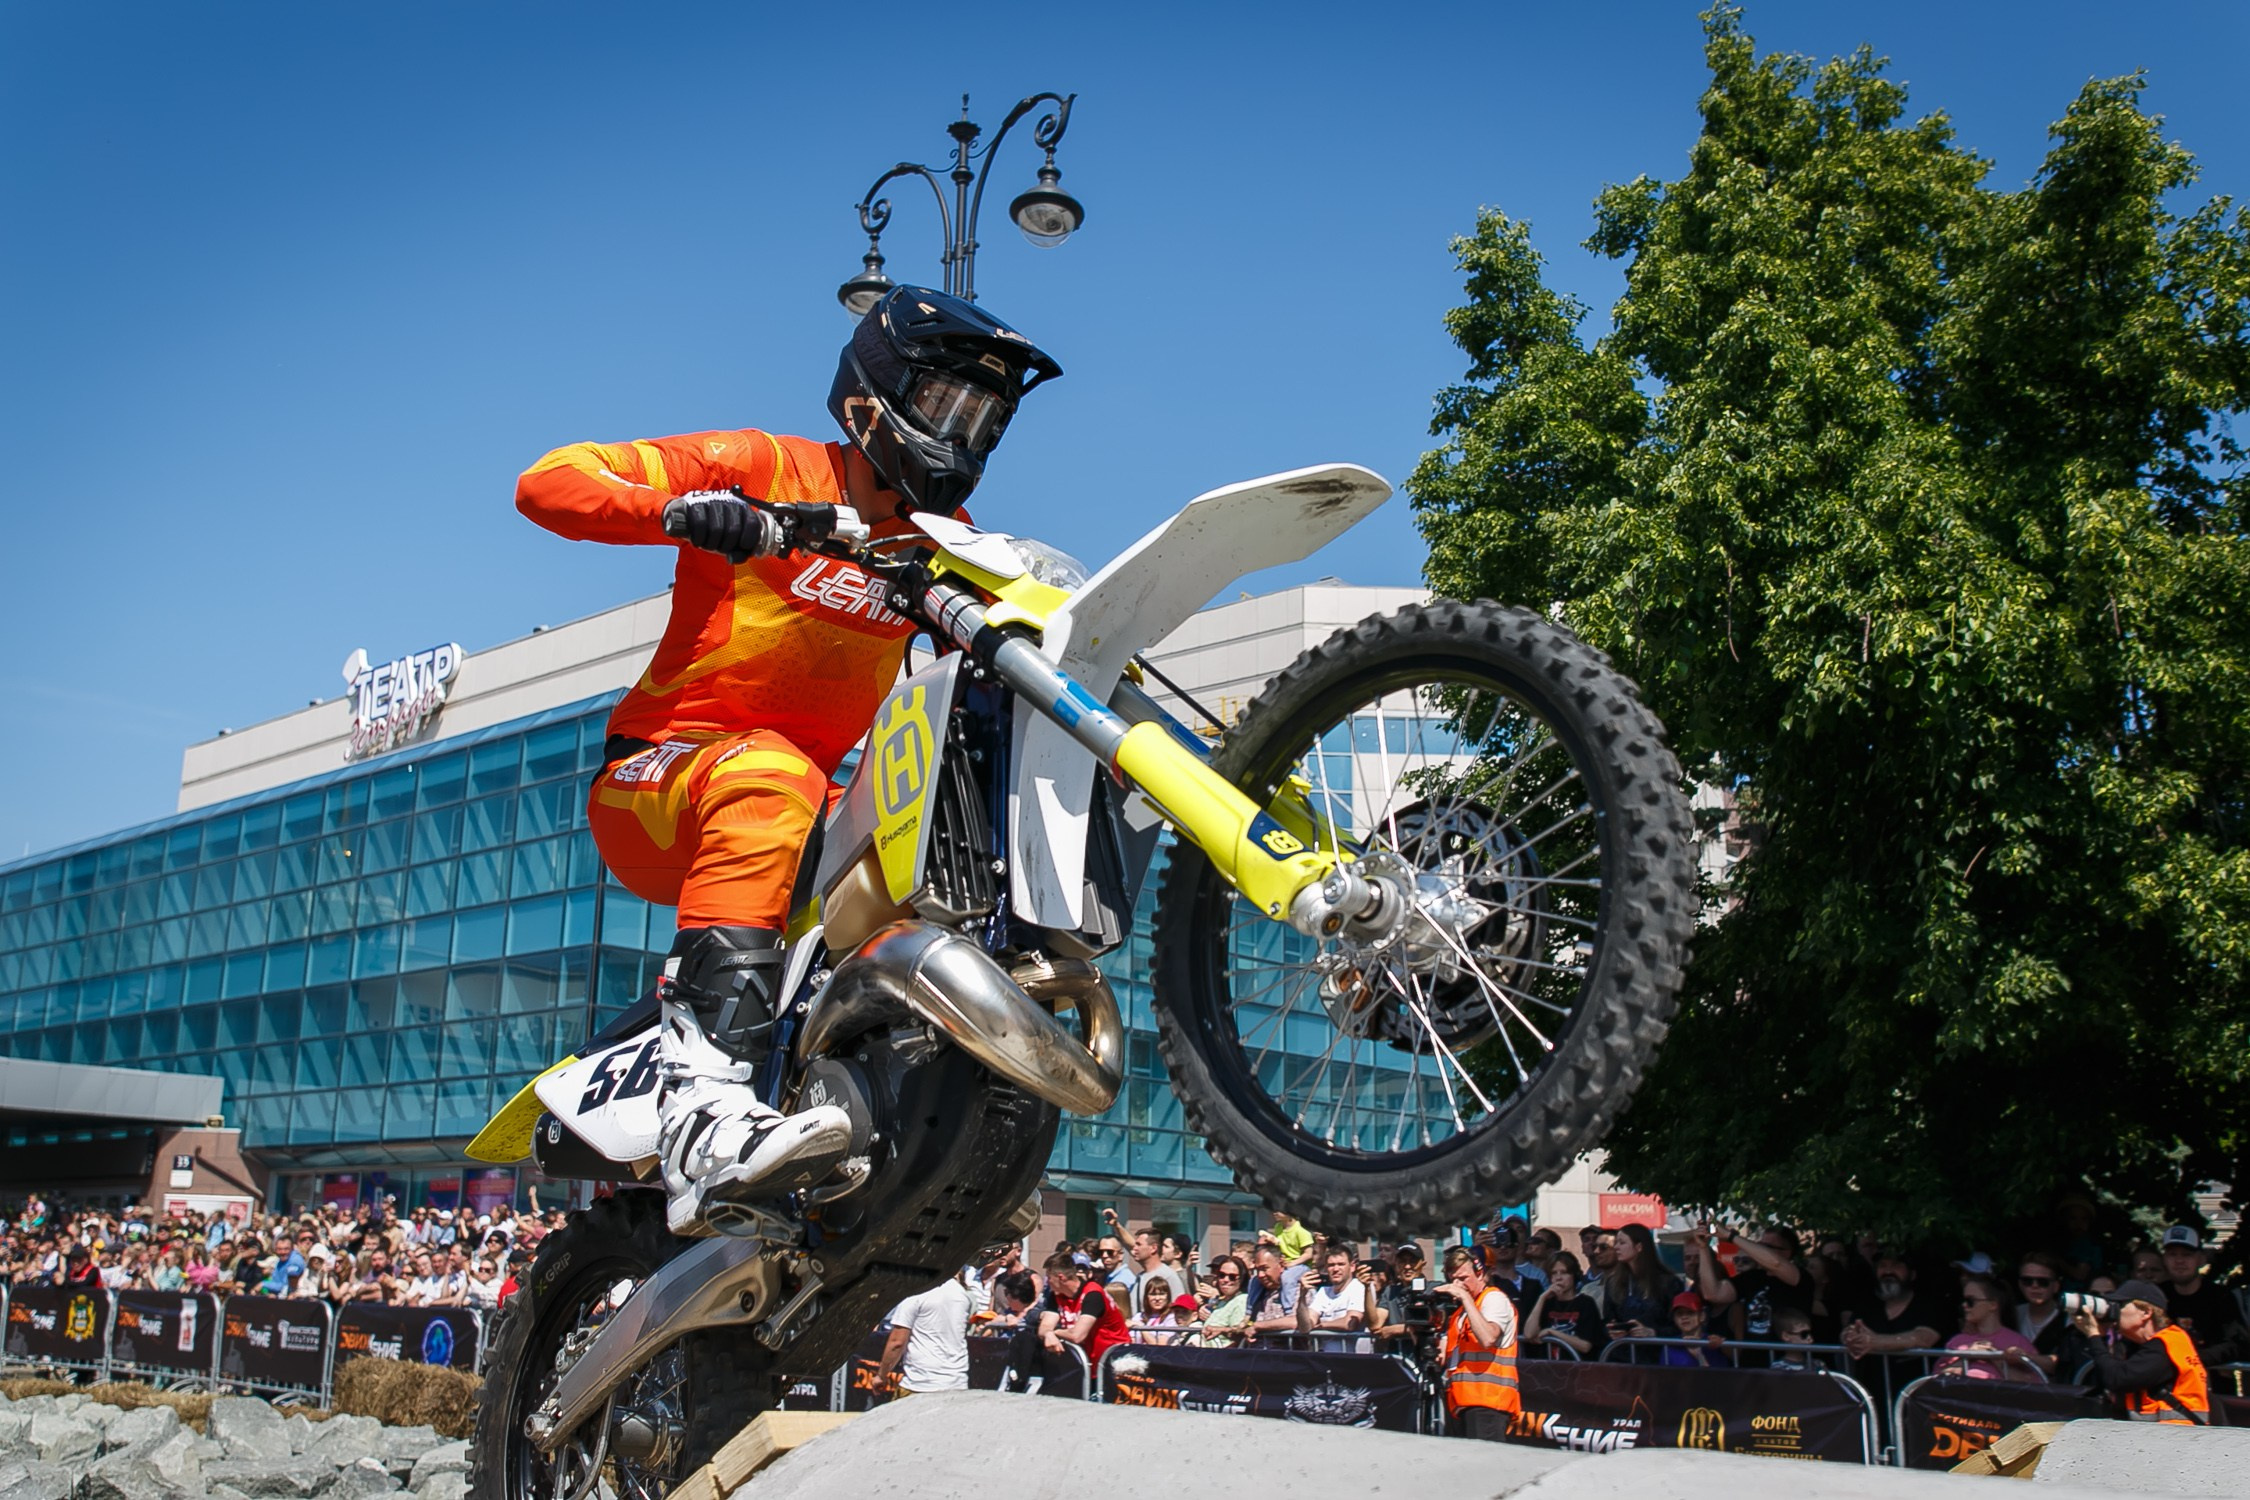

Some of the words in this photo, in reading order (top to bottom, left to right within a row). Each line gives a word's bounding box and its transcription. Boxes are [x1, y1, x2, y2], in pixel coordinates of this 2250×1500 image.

[790, 557, 906, 626] LEA
[355, 642, 457, 721] ТЕАТР
[720, 955, 749, 966] LEATT
[577, 1035, 661, 1116] 56
[1606, 1203, 1655, 1215] МАКСИМ
[1612, 1418, 1642, 1428] УРАЛ
[1751, 1414, 1802, 1433] ФОНД
